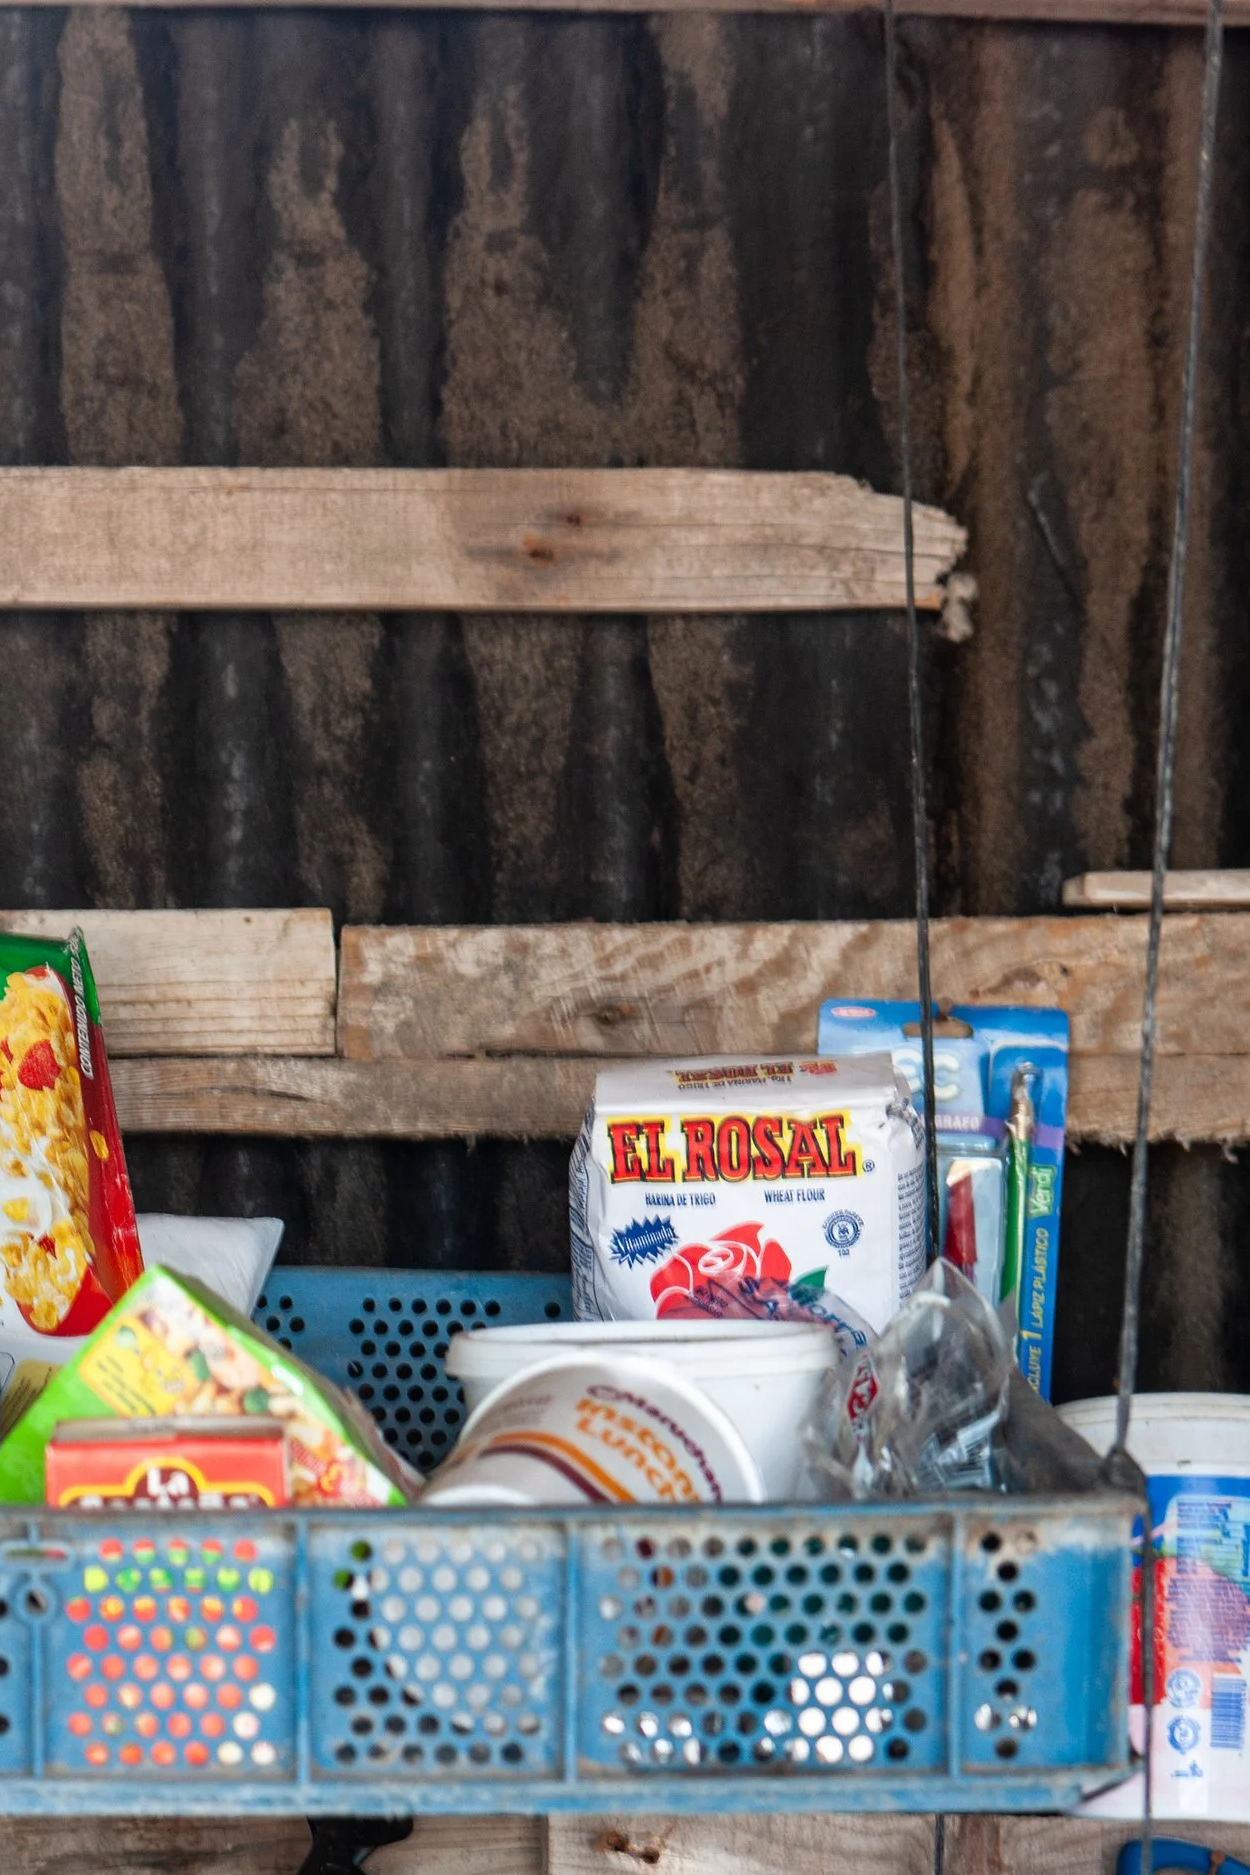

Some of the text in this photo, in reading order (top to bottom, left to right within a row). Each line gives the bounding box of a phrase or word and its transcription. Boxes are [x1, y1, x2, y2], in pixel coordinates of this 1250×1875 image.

[70, 957, 86, 998] NETO
[75, 994, 95, 1081] CONTENIDO
[607, 1113, 858, 1184] EL ROSAL
[645, 1191, 717, 1206] HARINA DE TRIGO
[764, 1188, 826, 1204] WHEAT FLOUR
[616, 1225, 675, 1256] Vitaminada
[1021, 1328, 1043, 1342] 1
[146, 1467, 190, 1500] La
